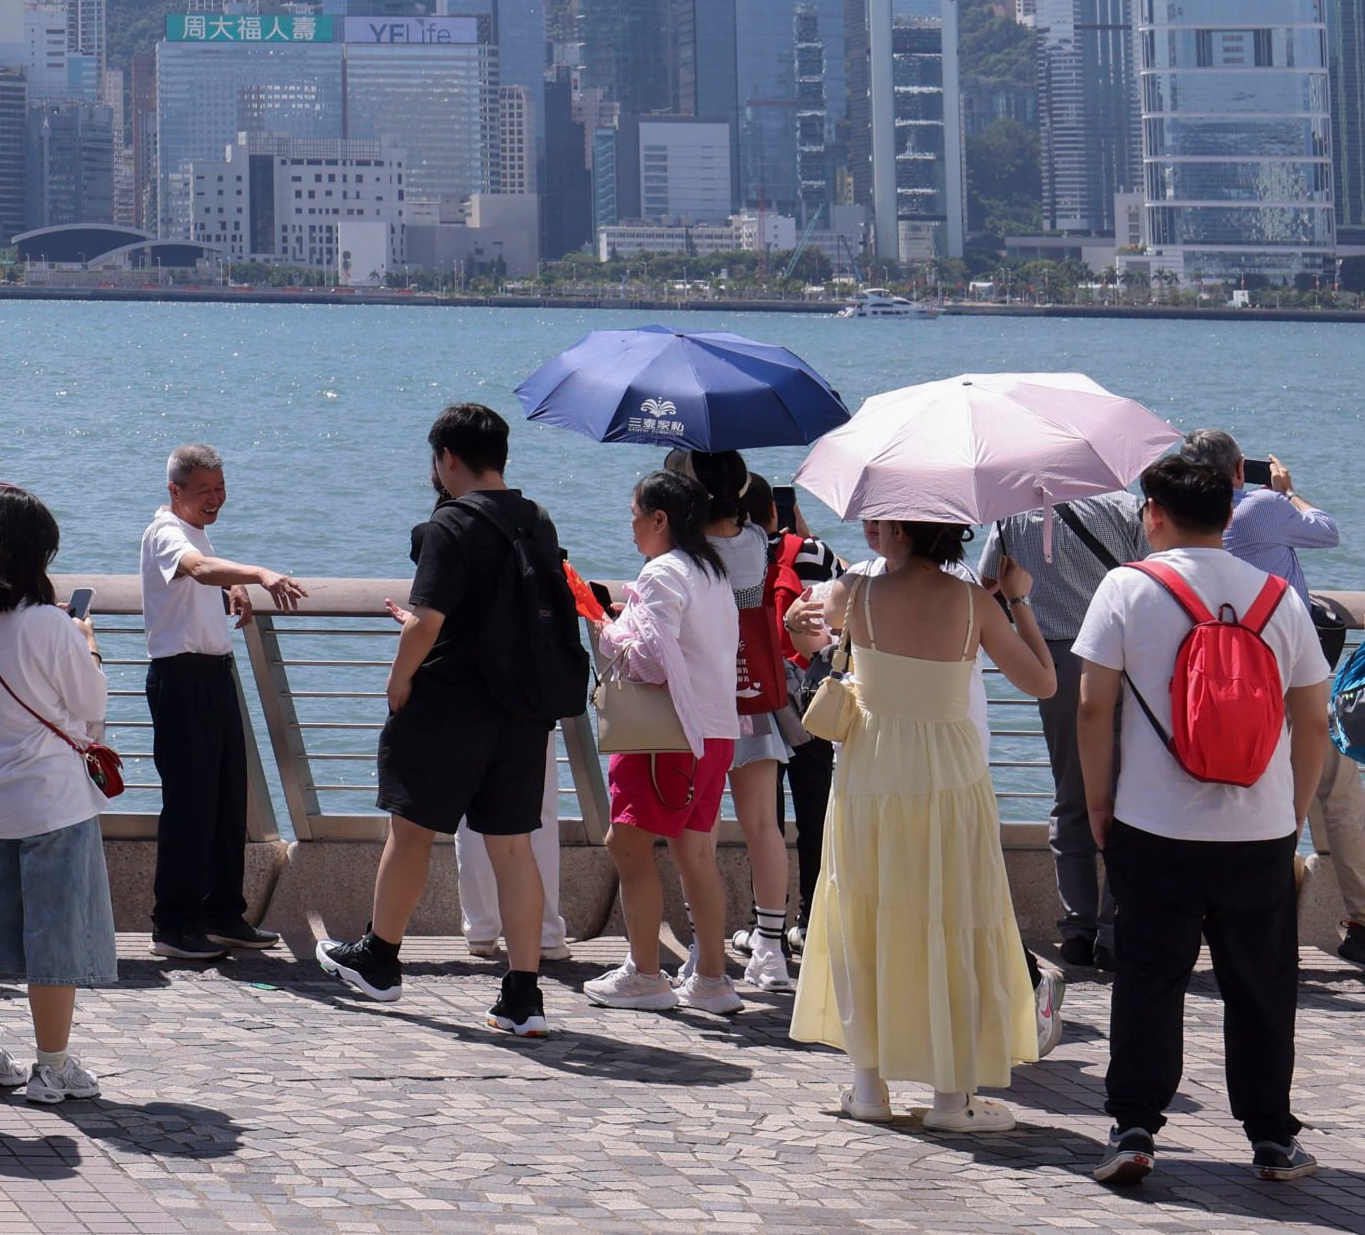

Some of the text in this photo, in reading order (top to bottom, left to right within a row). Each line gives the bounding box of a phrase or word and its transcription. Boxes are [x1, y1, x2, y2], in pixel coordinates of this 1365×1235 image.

[182, 15, 317, 41] 周大福人壽
